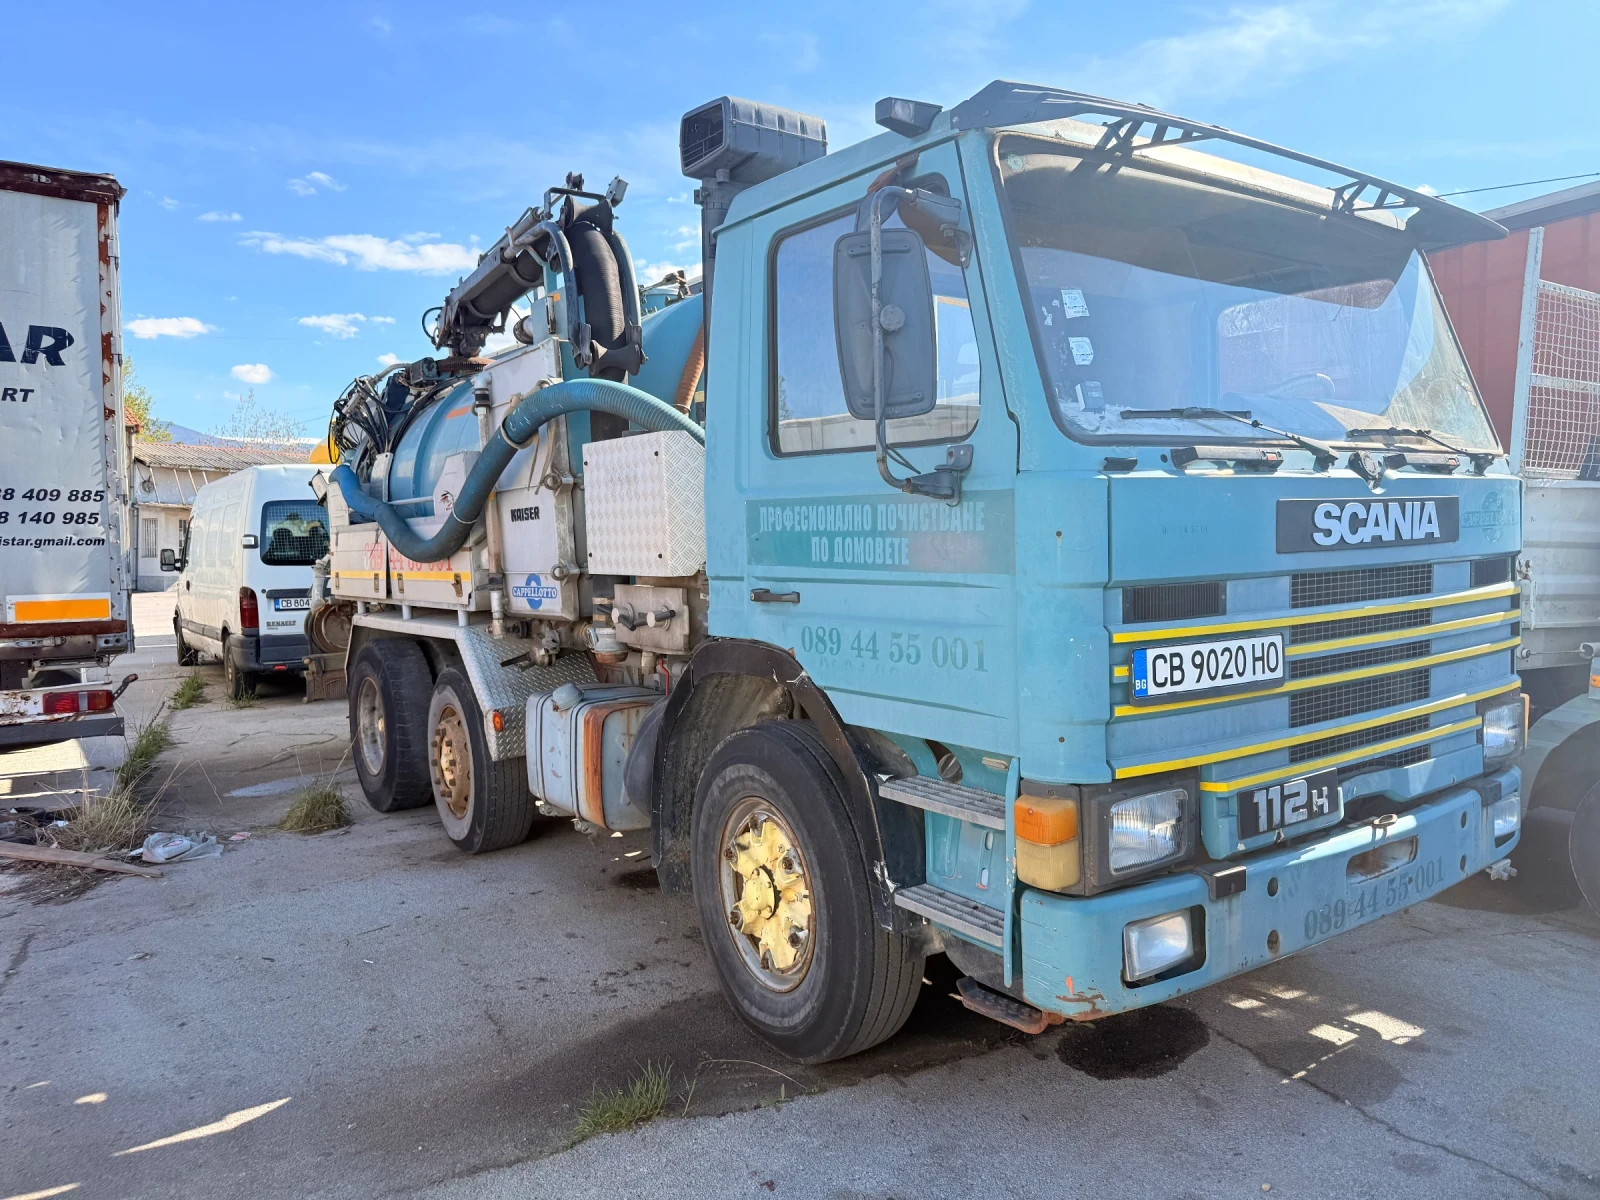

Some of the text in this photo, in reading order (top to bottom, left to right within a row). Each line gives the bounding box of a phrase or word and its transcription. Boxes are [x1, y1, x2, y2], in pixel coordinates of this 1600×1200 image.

[1, 387, 35, 402] RT
[0, 488, 105, 502] 8 409 885
[18, 511, 56, 525] 140
[62, 511, 100, 525] 985
[510, 506, 540, 522] KAISER
[760, 501, 985, 532] ПРОФЕСИОНАЛНО ПОЧИСТВАНЕ
[1312, 501, 1441, 546] SCANIA
[811, 536, 910, 565] ПО ДОМОВЕТЕ
[512, 587, 557, 598] CAPPELLOTTO
[281, 600, 293, 608] CB
[294, 599, 311, 608] 804
[266, 620, 297, 628] RENAULT
[801, 625, 842, 656] 089
[850, 629, 880, 660] 44
[889, 632, 922, 665] 55
[931, 636, 989, 673] 001
[1151, 641, 1280, 688] CB 9020 HO
[1135, 679, 1147, 690] BG
[1253, 779, 1329, 833] 112 H
[1304, 856, 1446, 940] 089 44 55 001
